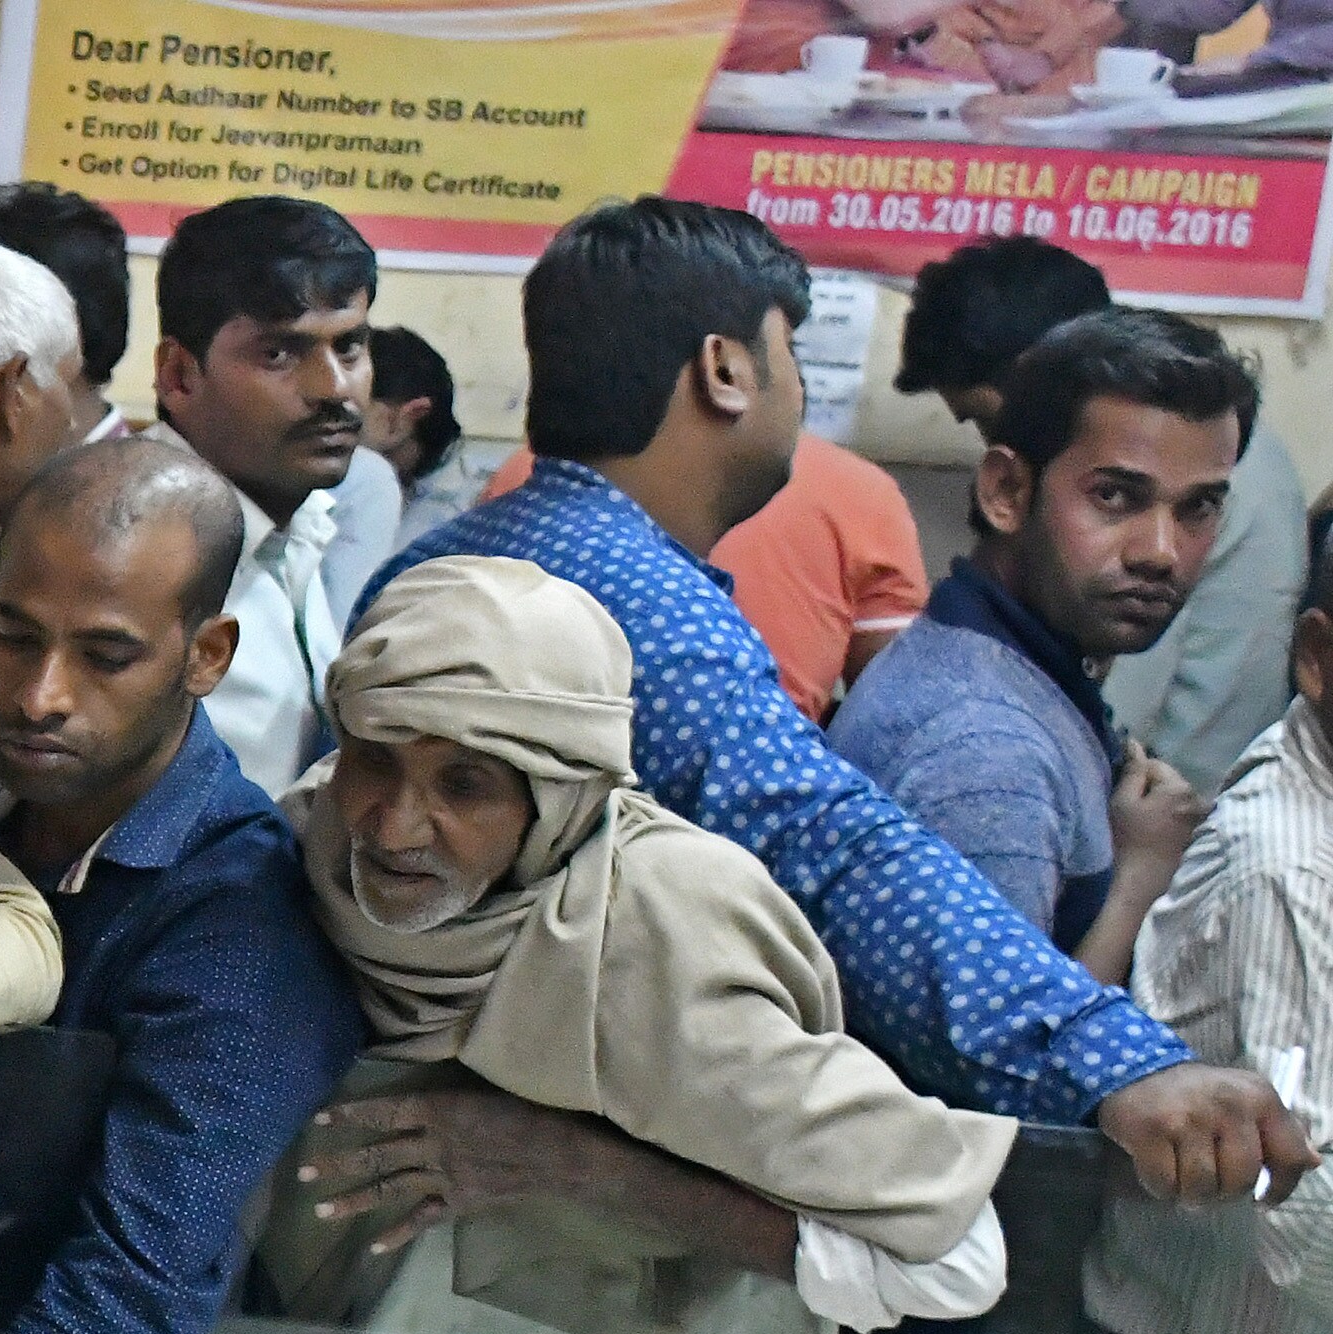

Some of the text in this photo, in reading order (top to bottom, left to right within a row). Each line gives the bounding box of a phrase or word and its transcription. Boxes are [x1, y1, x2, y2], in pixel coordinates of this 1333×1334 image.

[71, 30, 335, 77] Dear Pensioner,
[86, 79, 586, 128] Seed Aadhaar Number to SB Account
[82, 116, 422, 155] Enroll for Jeevanpramaan
[78, 153, 561, 200] Get Option for Digital Life Certificate
[751, 149, 955, 196] PENSIONERS
[965, 160, 1056, 199] MELA
[1086, 165, 1260, 208] CAMPAIGN
[748, 188, 1252, 248] from 30.05.2016 to 10.06.2016
